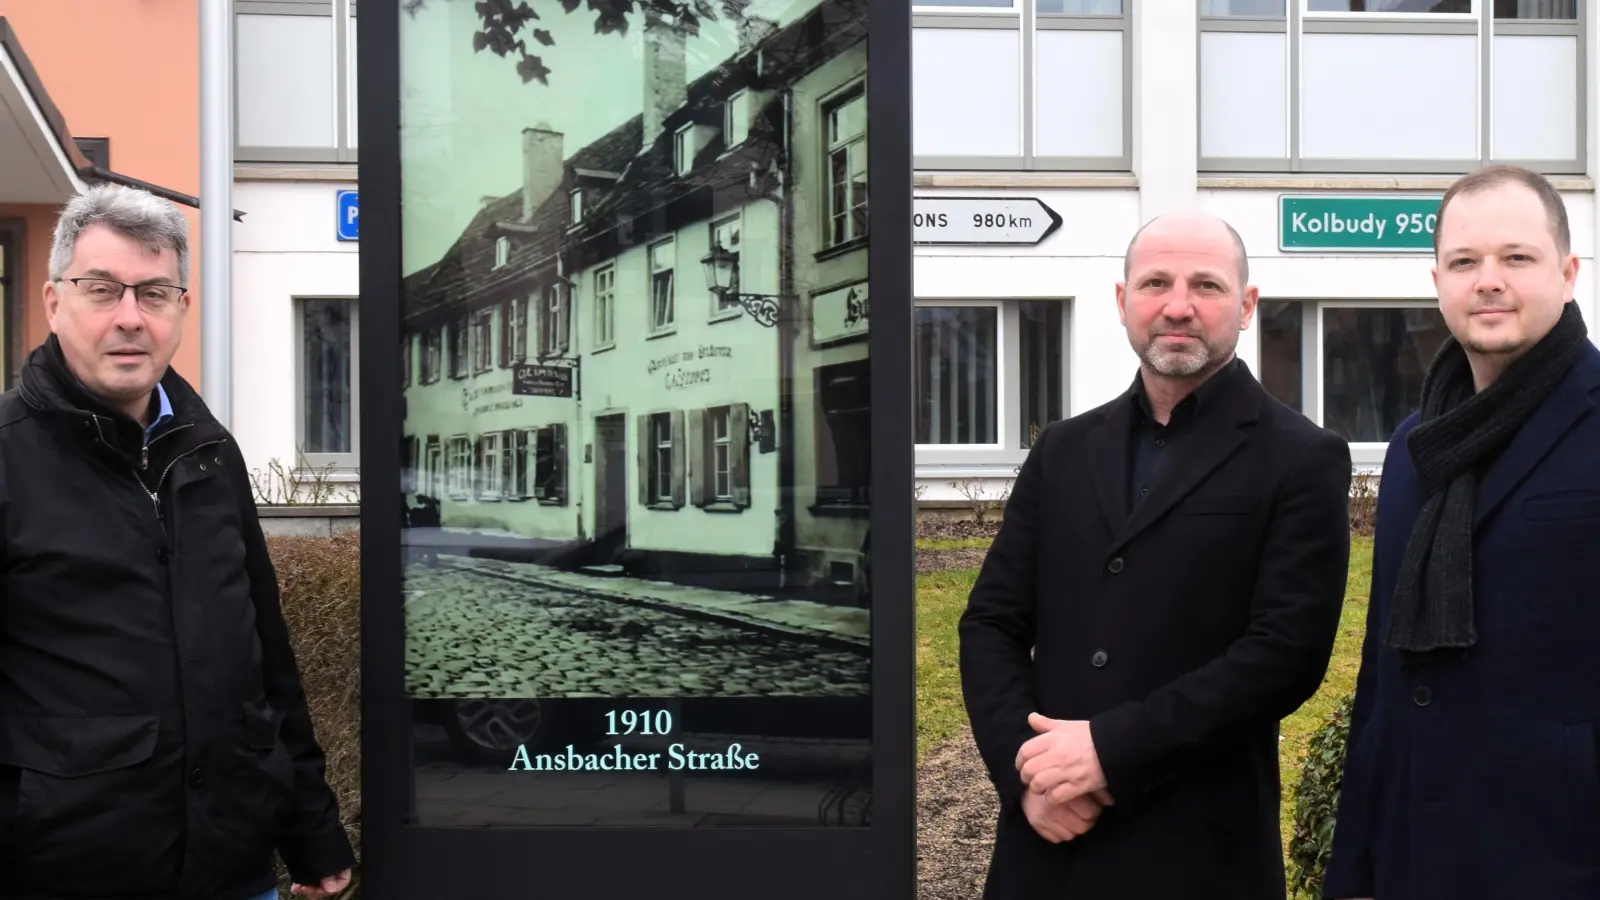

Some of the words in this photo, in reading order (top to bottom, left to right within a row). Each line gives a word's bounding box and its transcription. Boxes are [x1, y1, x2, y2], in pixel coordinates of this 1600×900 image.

[1292, 212, 1387, 239] Kolbudy
[1395, 213, 1437, 234] 950
[605, 709, 673, 735] 1910
[508, 743, 661, 771] Ansbacher
[668, 742, 760, 771] Straße
